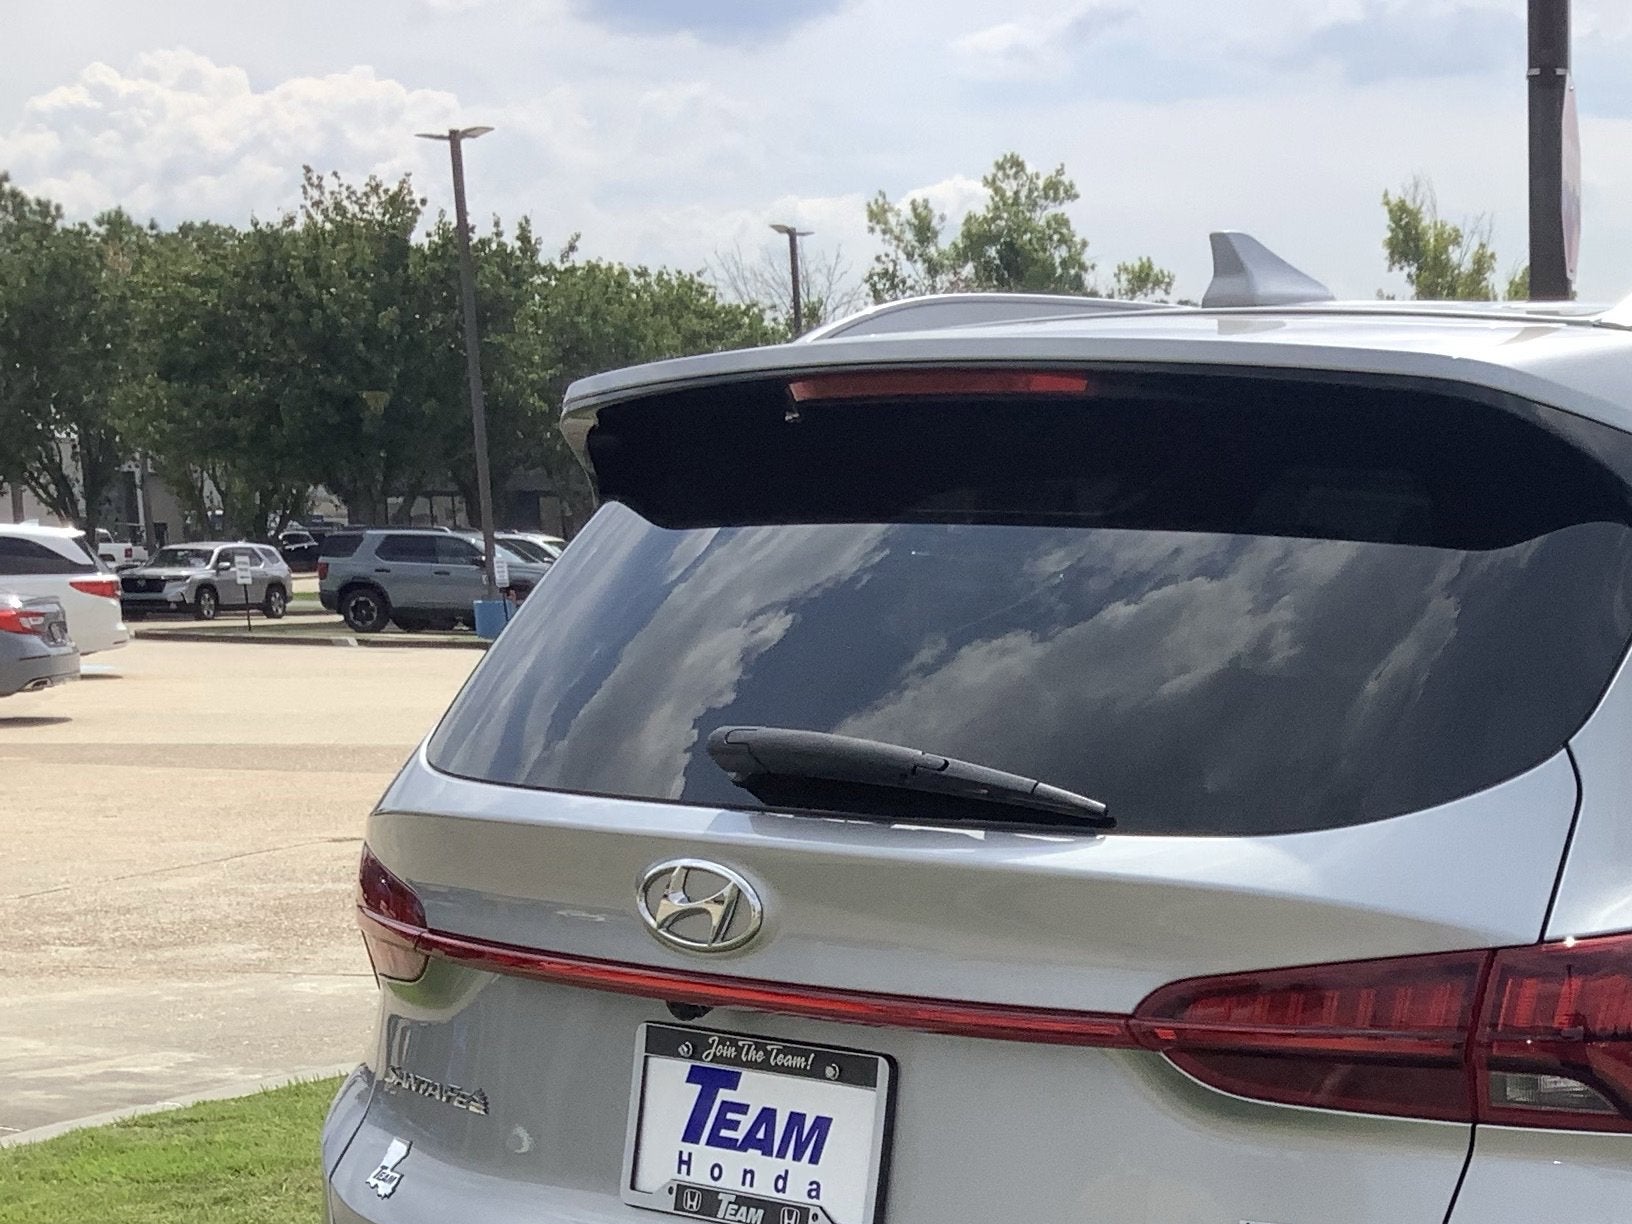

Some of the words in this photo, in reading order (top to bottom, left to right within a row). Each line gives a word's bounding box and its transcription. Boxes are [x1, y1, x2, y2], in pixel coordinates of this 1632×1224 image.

[702, 1036, 737, 1062] Join
[738, 1041, 765, 1063] The
[767, 1045, 815, 1070] Team!
[681, 1064, 833, 1165] TEAM
[676, 1150, 822, 1201] Honda
